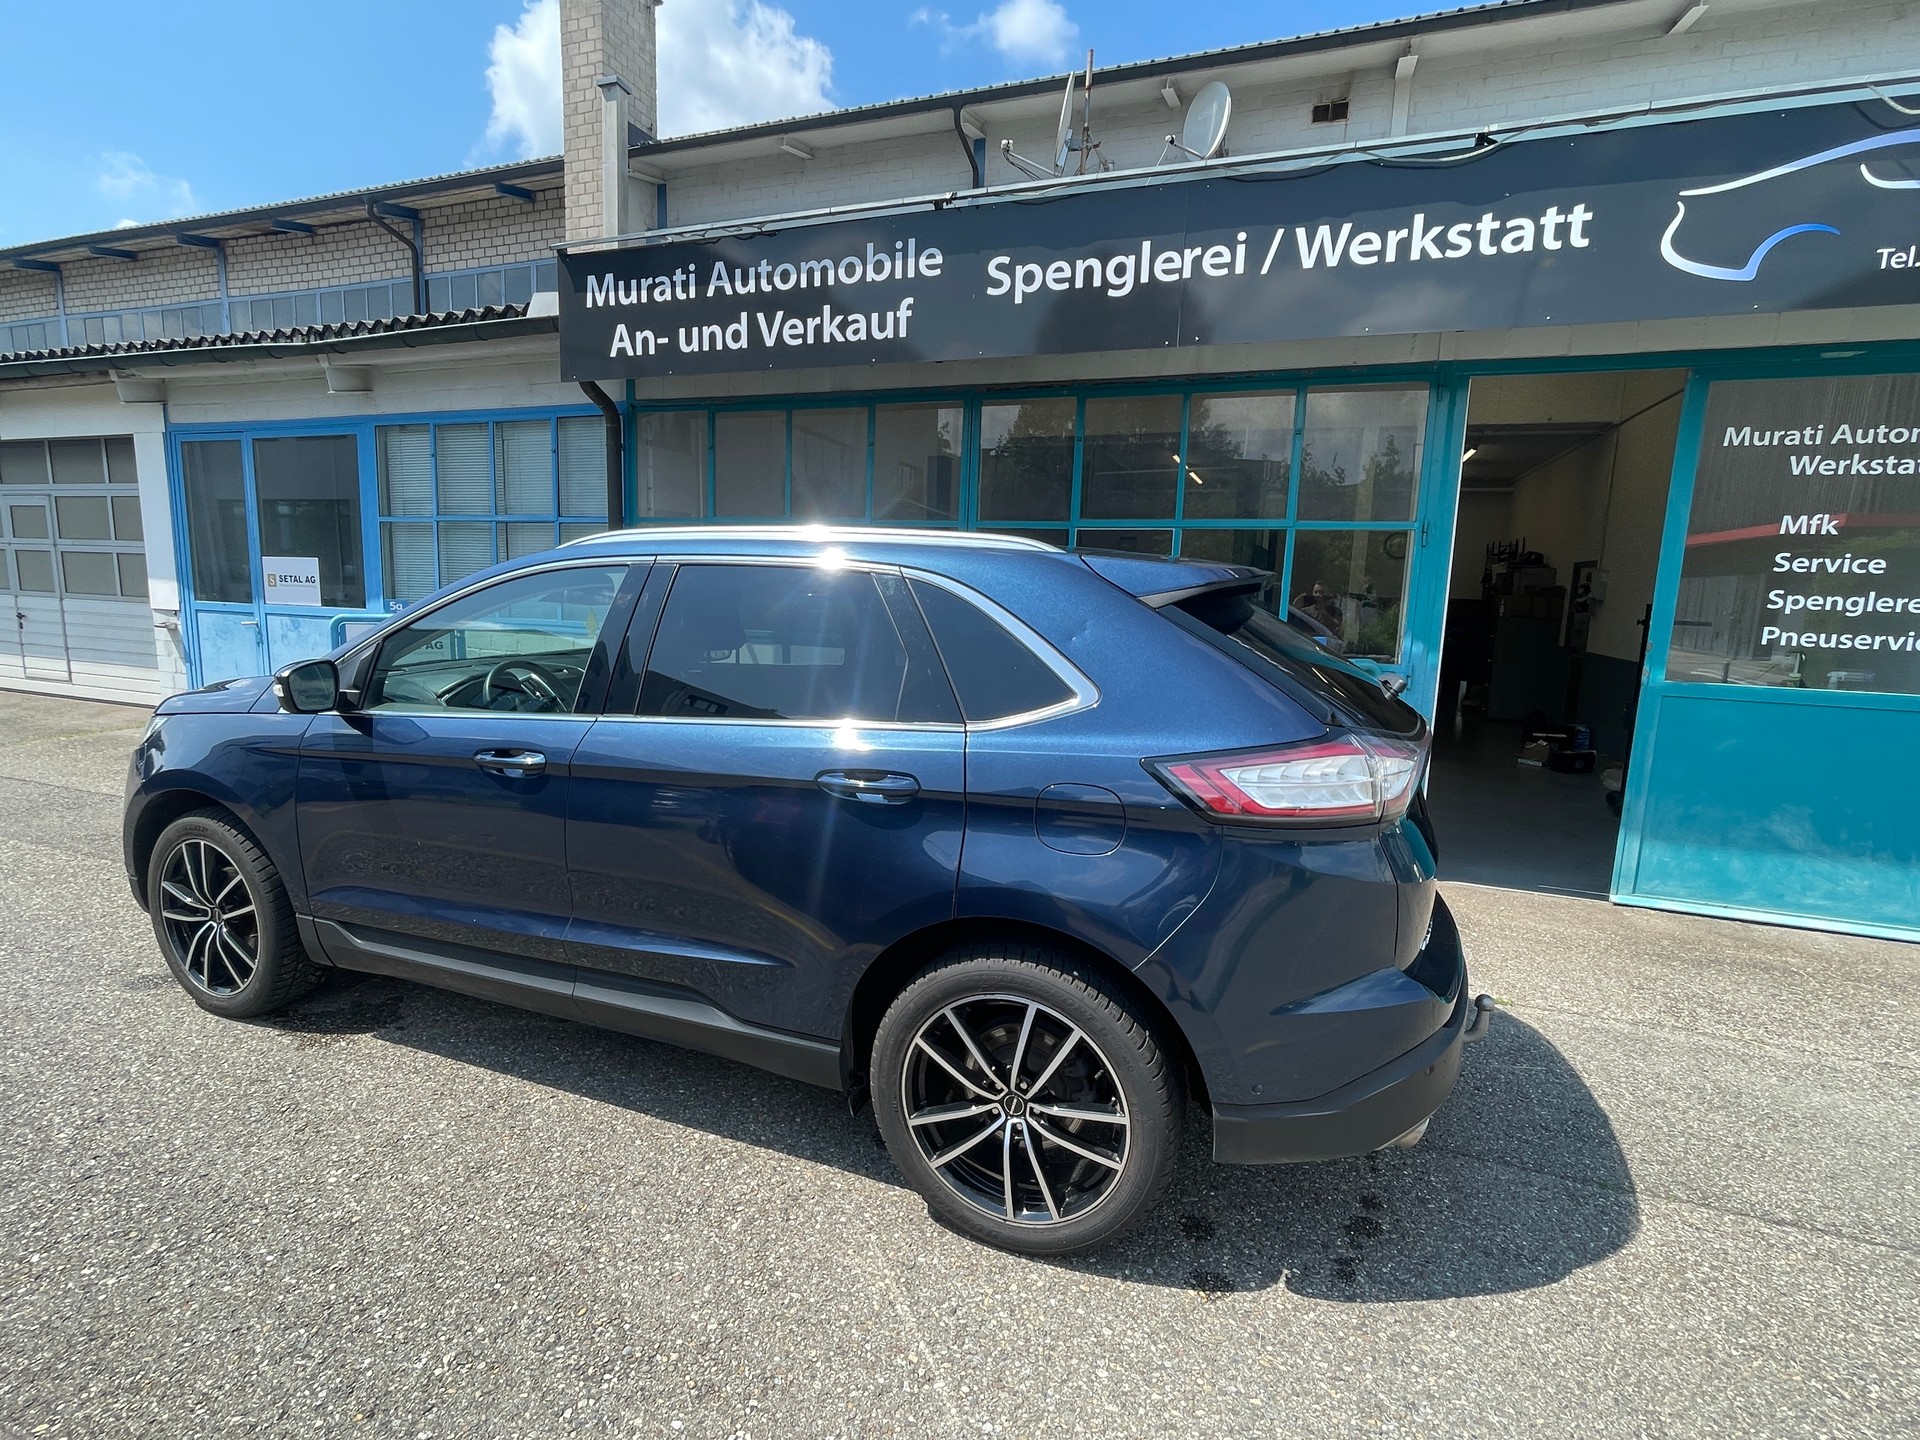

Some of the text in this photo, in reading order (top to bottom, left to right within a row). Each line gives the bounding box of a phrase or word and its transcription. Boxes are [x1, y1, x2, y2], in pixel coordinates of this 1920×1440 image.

[986, 203, 1594, 305] Spenglerei / Werkstatt
[1876, 244, 1920, 270] Tel.
[585, 237, 944, 309] Murati Automobile
[609, 296, 915, 358] An- und Verkauf
[1722, 423, 1920, 447] Murati Auto
[1789, 453, 1920, 476] Werksta
[1779, 513, 1840, 535] Mfk
[1772, 552, 1888, 575] Service
[278, 574, 316, 584] SETAL AG
[1766, 589, 1920, 617] Spenglere
[425, 641, 444, 650] AG
